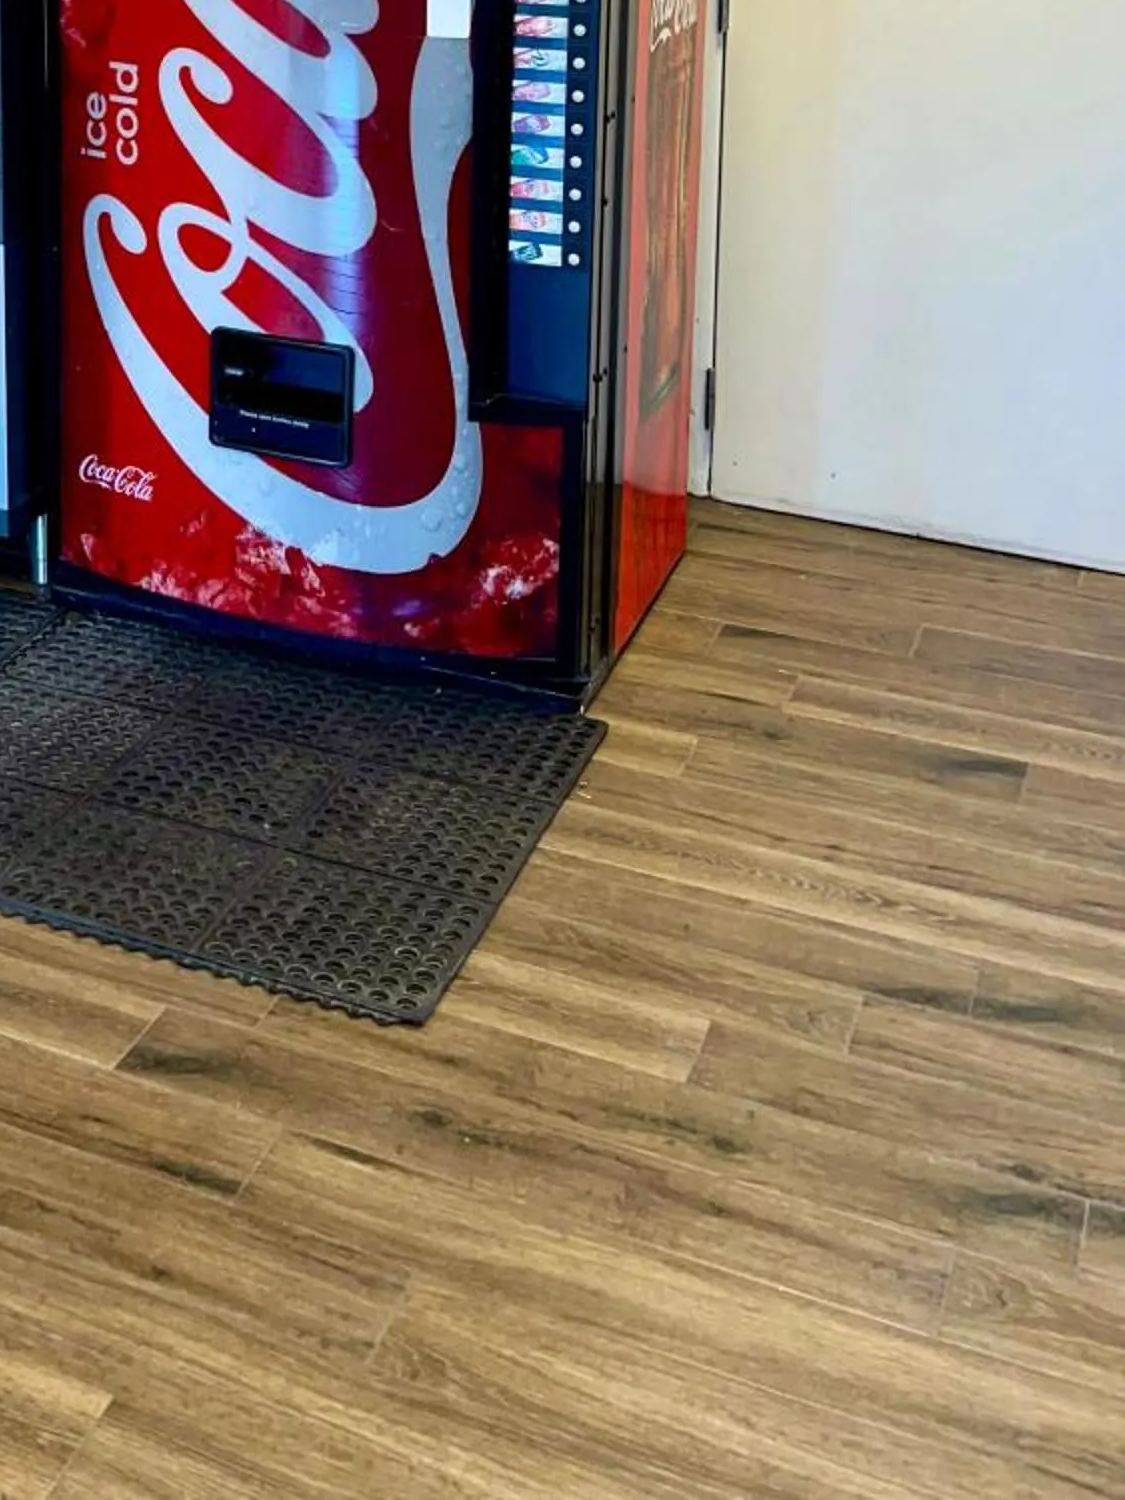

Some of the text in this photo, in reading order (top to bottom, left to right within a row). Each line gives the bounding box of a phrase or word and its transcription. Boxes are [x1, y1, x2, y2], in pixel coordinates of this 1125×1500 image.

[80, 91, 107, 159] ice
[108, 60, 139, 165] cold
[78, 453, 157, 503] Coca-Cola
